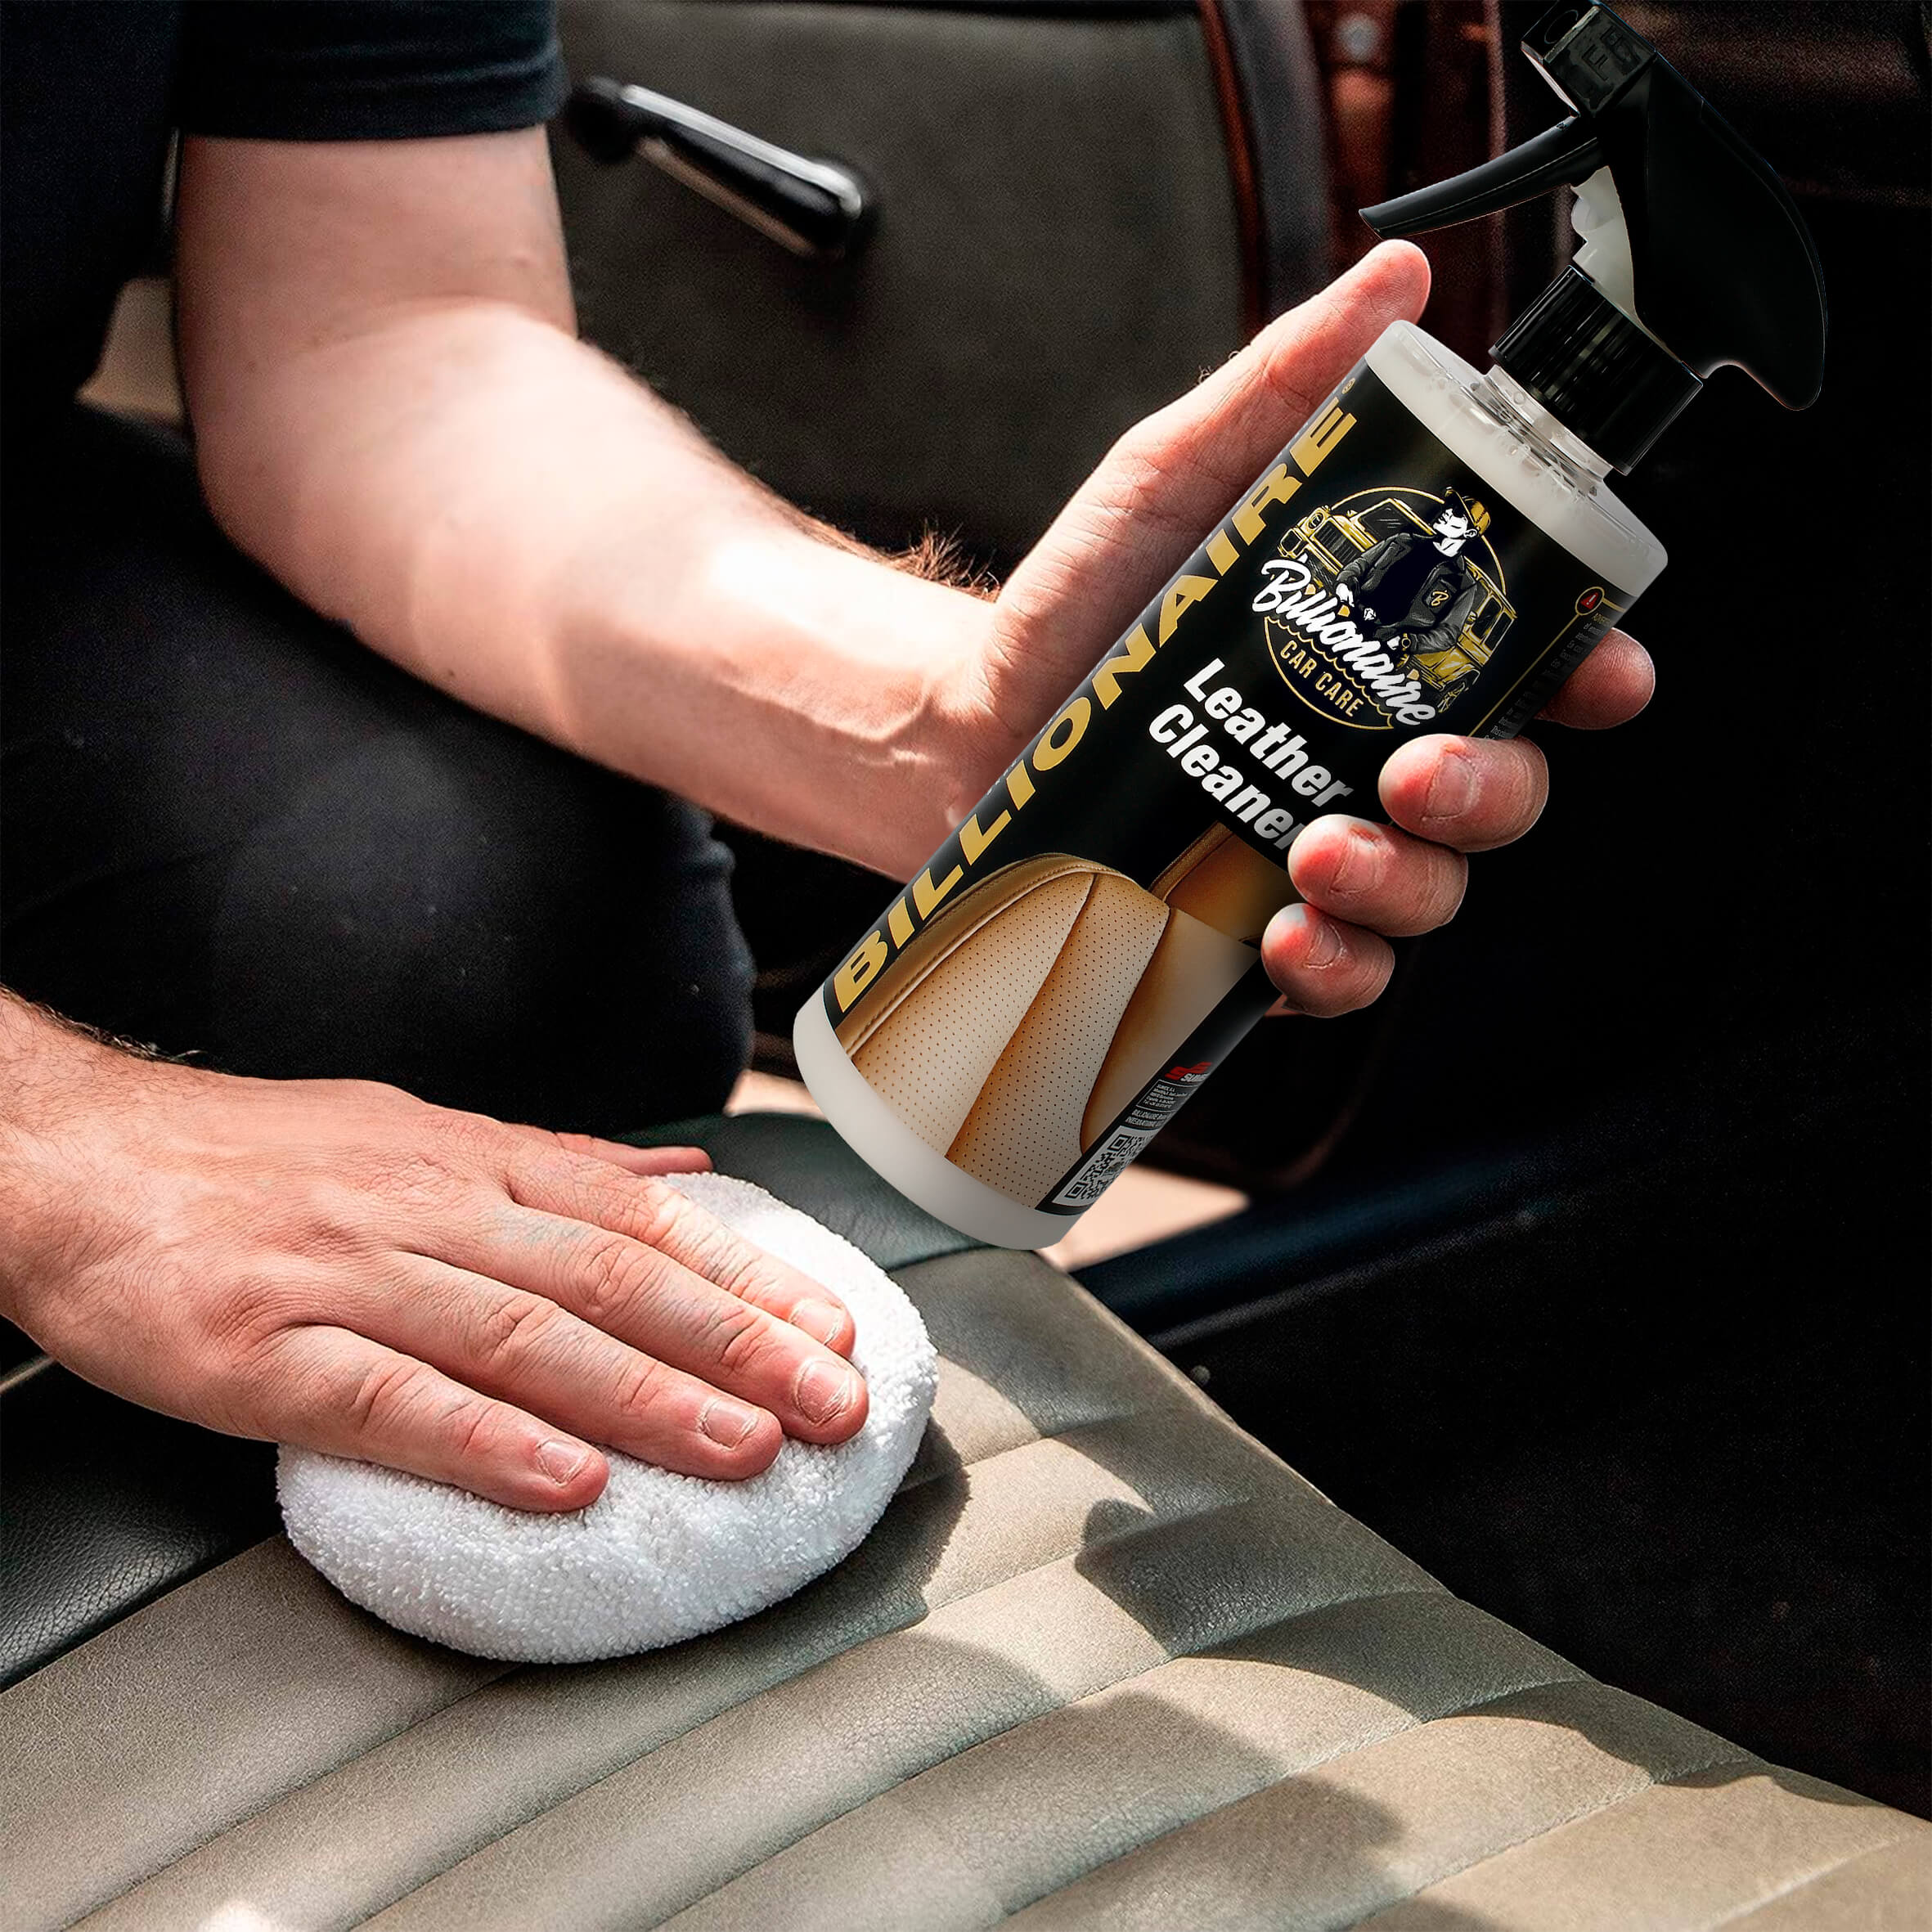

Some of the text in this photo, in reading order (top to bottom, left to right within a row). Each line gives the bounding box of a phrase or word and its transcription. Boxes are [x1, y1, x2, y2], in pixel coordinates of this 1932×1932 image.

[1251, 553, 1436, 726] Billionaire
[1279, 640, 1365, 717] CAR CARE
[1183, 658, 1355, 807] Leather
